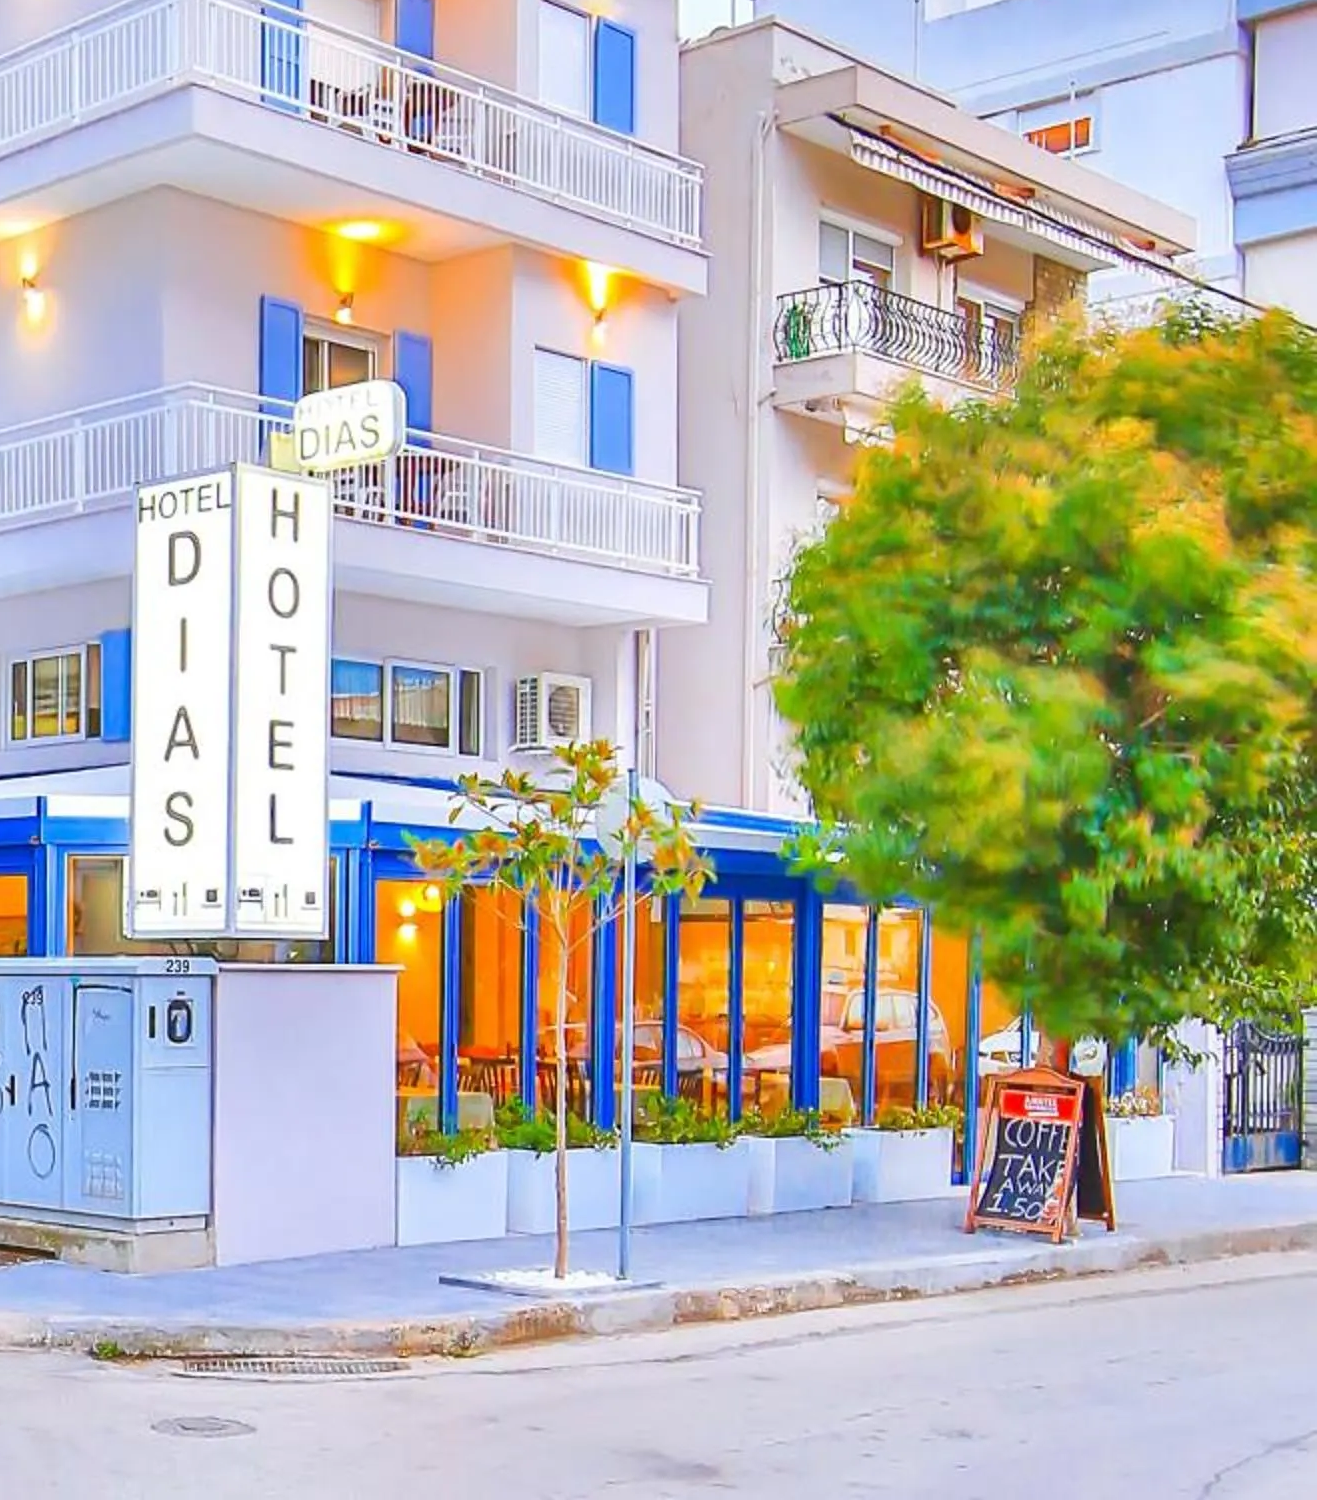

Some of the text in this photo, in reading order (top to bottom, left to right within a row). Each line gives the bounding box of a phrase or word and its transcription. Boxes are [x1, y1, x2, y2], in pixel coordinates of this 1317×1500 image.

[300, 414, 381, 462] DIAS
[138, 482, 232, 524] HOTEL
[163, 530, 202, 847] DIAS
[268, 487, 301, 845] HOTEL
[166, 959, 191, 973] 239
